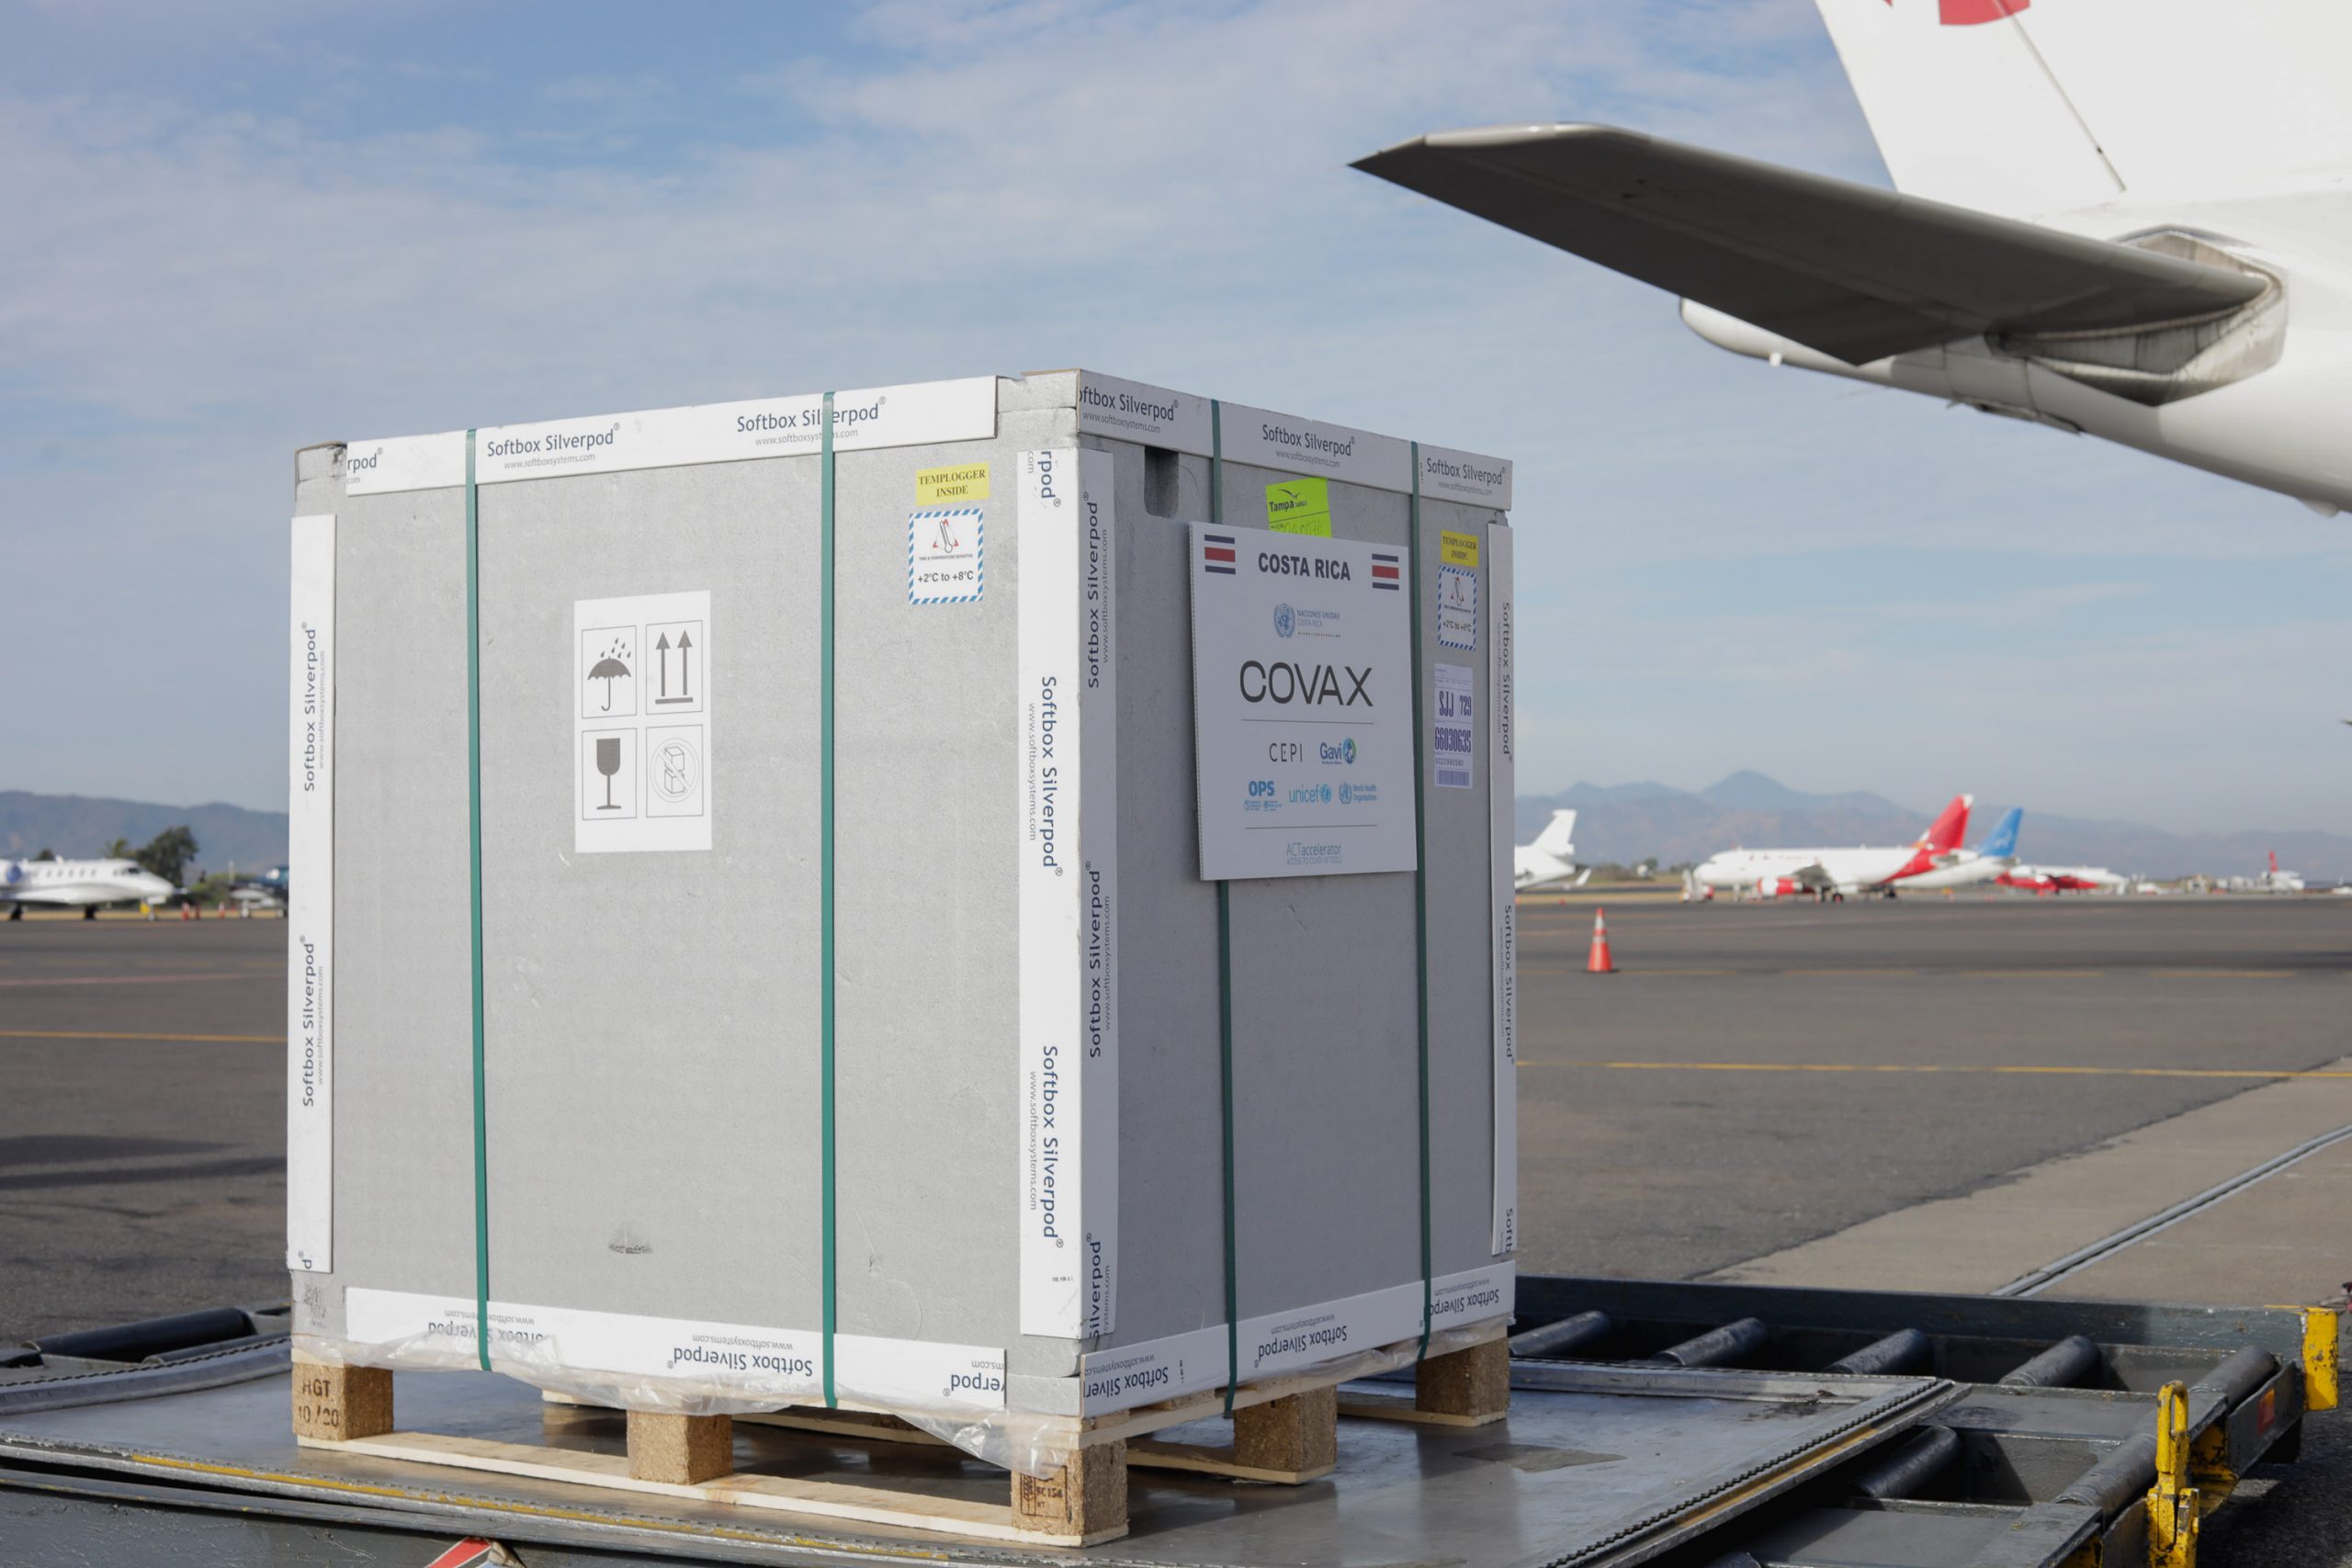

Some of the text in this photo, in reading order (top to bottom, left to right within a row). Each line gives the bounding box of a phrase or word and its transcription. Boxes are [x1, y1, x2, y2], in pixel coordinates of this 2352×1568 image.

[738, 412, 797, 433] Softbox
[1083, 412, 1161, 434] www.softboxsystems.com
[755, 429, 858, 446] www.softboxsysts.com
[1262, 424, 1302, 447] Softbox
[488, 439, 540, 457] Softbox
[503, 454, 595, 468] www.softboxsystems.com
[1275, 450, 1340, 468] www.softboxsystems.com
[1427, 457, 1461, 478] Softbox
[919, 469, 986, 485] TEMPLOGGER
[936, 485, 968, 497] INSIDE
[1270, 501, 1295, 513] Tampa
[1442, 536, 1477, 550] TEMPLOGGER
[1258, 552, 1351, 581] COSTA RICA
[941, 573, 950, 581] to
[1296, 610, 1340, 620] NACIONES UNIDAS
[1089, 608, 1099, 688] Softbox
[1239, 660, 1374, 707] COVAX
[1439, 690, 1472, 716] SJJ 729
[1042, 676, 1057, 758] Softbox
[1434, 727, 1472, 753] 66030635
[305, 722, 315, 791] Softbox
[1269, 742, 1303, 762] CEPI
[1319, 742, 1342, 760] Gavi
[1028, 703, 1037, 840] www.softboxsystems.com
[1249, 781, 1275, 796] OPS
[1289, 784, 1320, 803] unicef
[1504, 905, 1512, 971] Softbox
[1091, 977, 1101, 1057] Softbox
[303, 1036, 314, 1107] Softbox
[1043, 1046, 1058, 1128] Softbox
[1028, 1072, 1038, 1210] www.softboxsystems.com
[1467, 1289, 1499, 1307] Softbox
[445, 1309, 535, 1325] www.softboxems.com
[1271, 1314, 1335, 1334] www.softboxsystems.com
[693, 1334, 793, 1350] www.softboxsystems.com
[1309, 1325, 1347, 1346] Softbox
[752, 1355, 813, 1377] Softbox
[302, 1378, 331, 1397] HGT
[1083, 1378, 1121, 1398] Silver
[1125, 1367, 1169, 1389] Softbox
